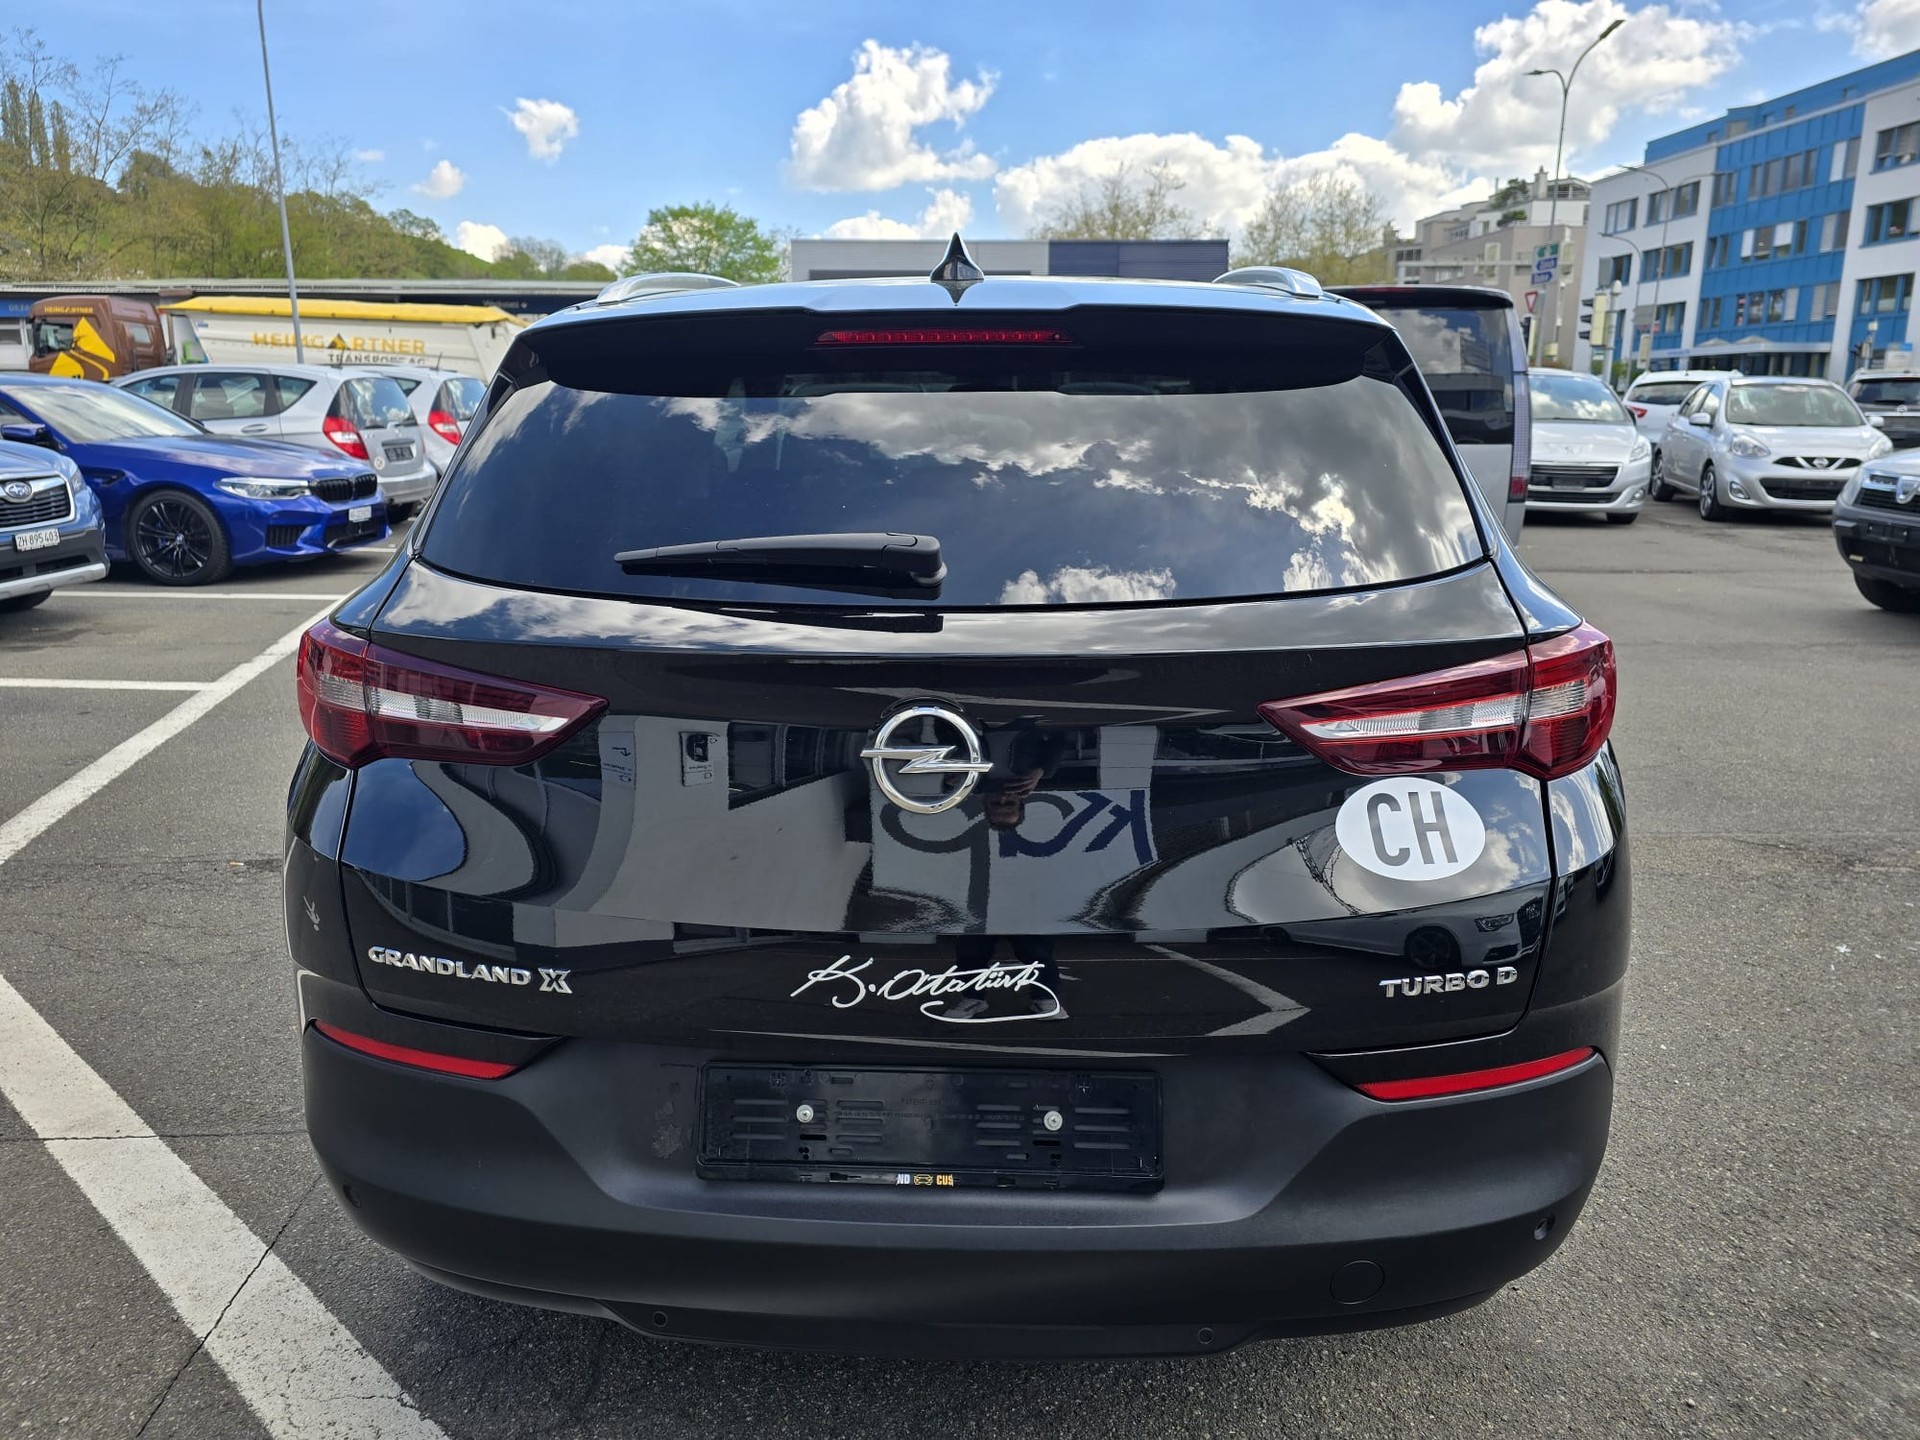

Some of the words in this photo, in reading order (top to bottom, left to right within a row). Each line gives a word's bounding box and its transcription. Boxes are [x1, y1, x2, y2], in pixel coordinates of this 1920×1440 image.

[17, 535, 27, 547] ZH
[1366, 791, 1458, 867] CH
[368, 945, 532, 986] GRANDLAND
[537, 966, 578, 994] X
[1379, 969, 1490, 998] TURBO
[1496, 966, 1518, 985] D
